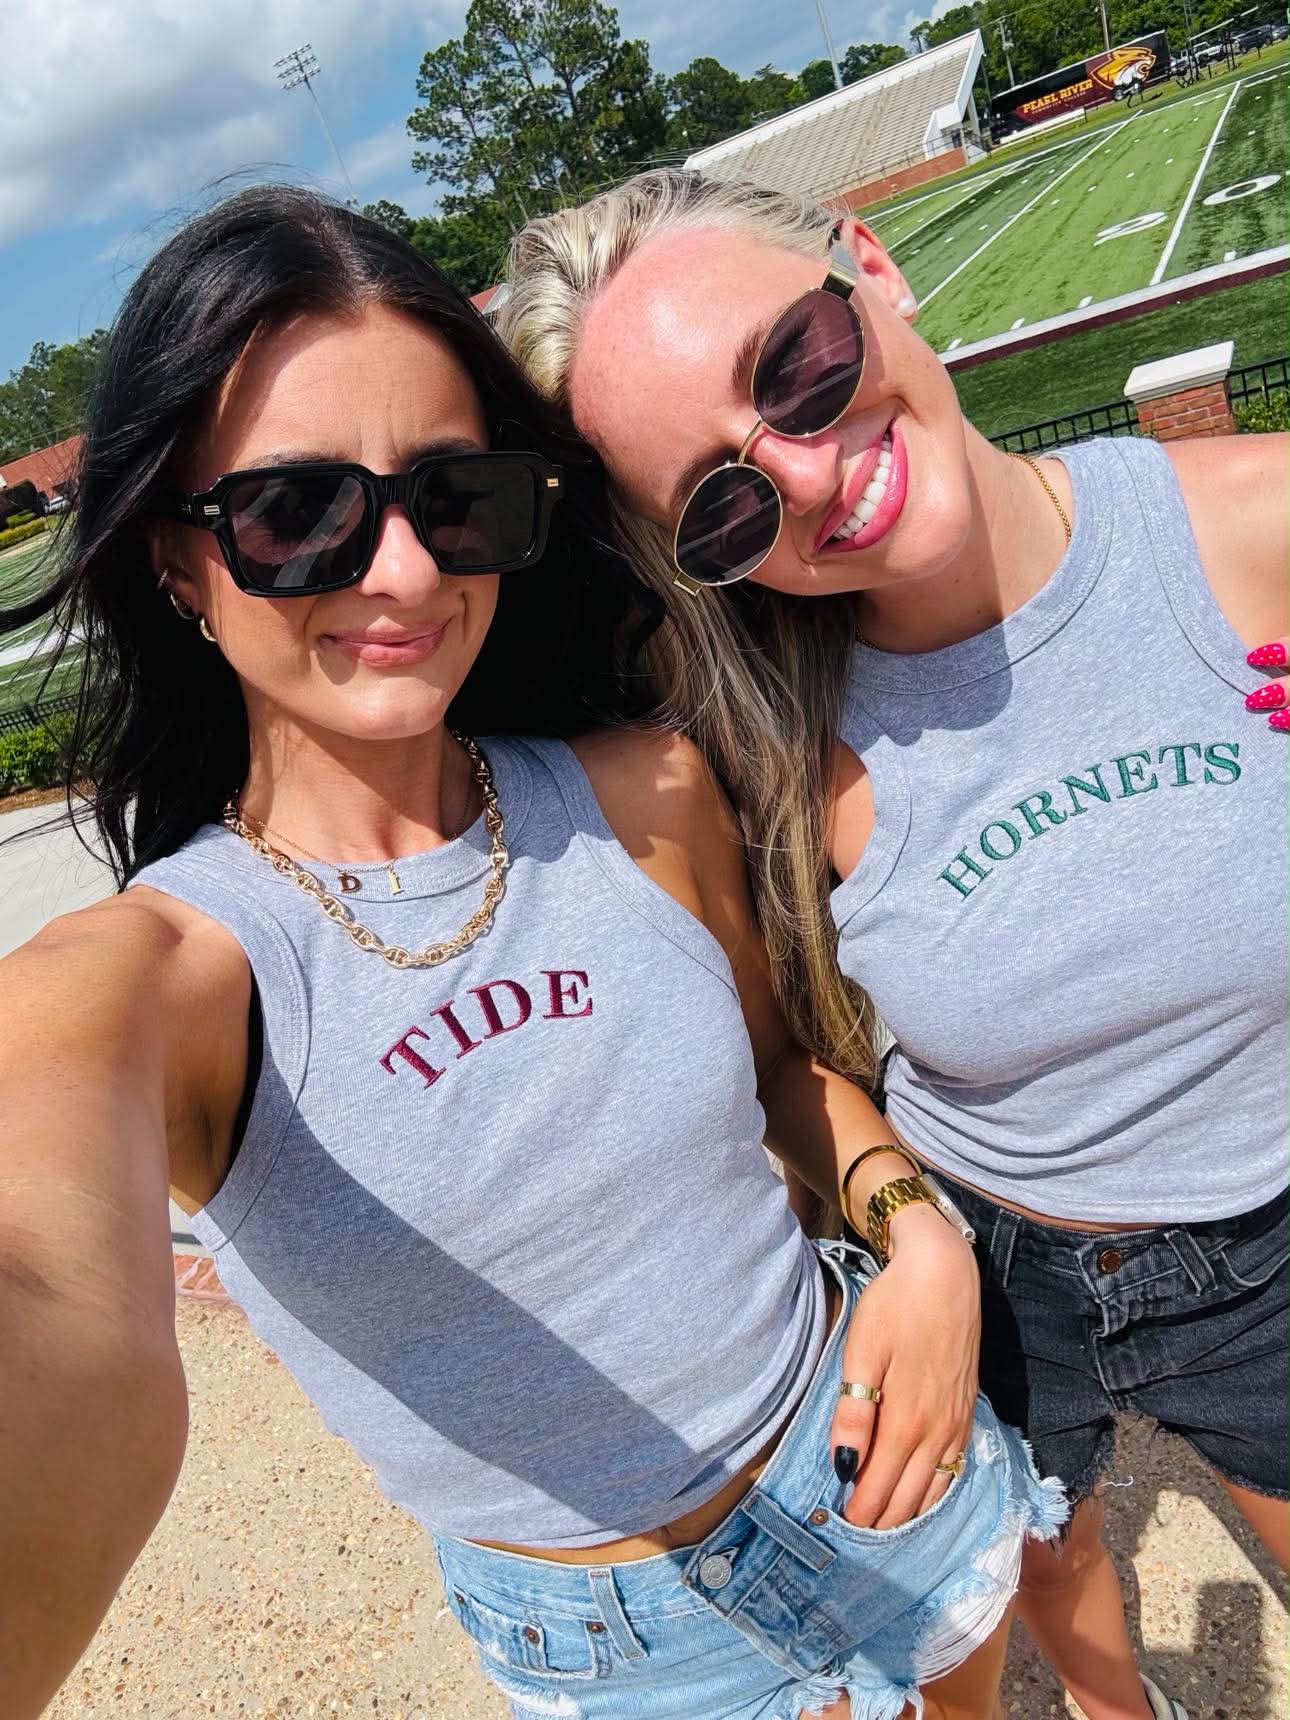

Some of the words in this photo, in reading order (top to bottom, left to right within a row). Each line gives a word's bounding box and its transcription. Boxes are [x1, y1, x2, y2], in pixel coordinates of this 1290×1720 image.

[1023, 93, 1058, 114] PEARL
[1059, 79, 1093, 99] RIVER
[936, 742, 1242, 902] HORNETS
[379, 970, 593, 1091] TIDE
